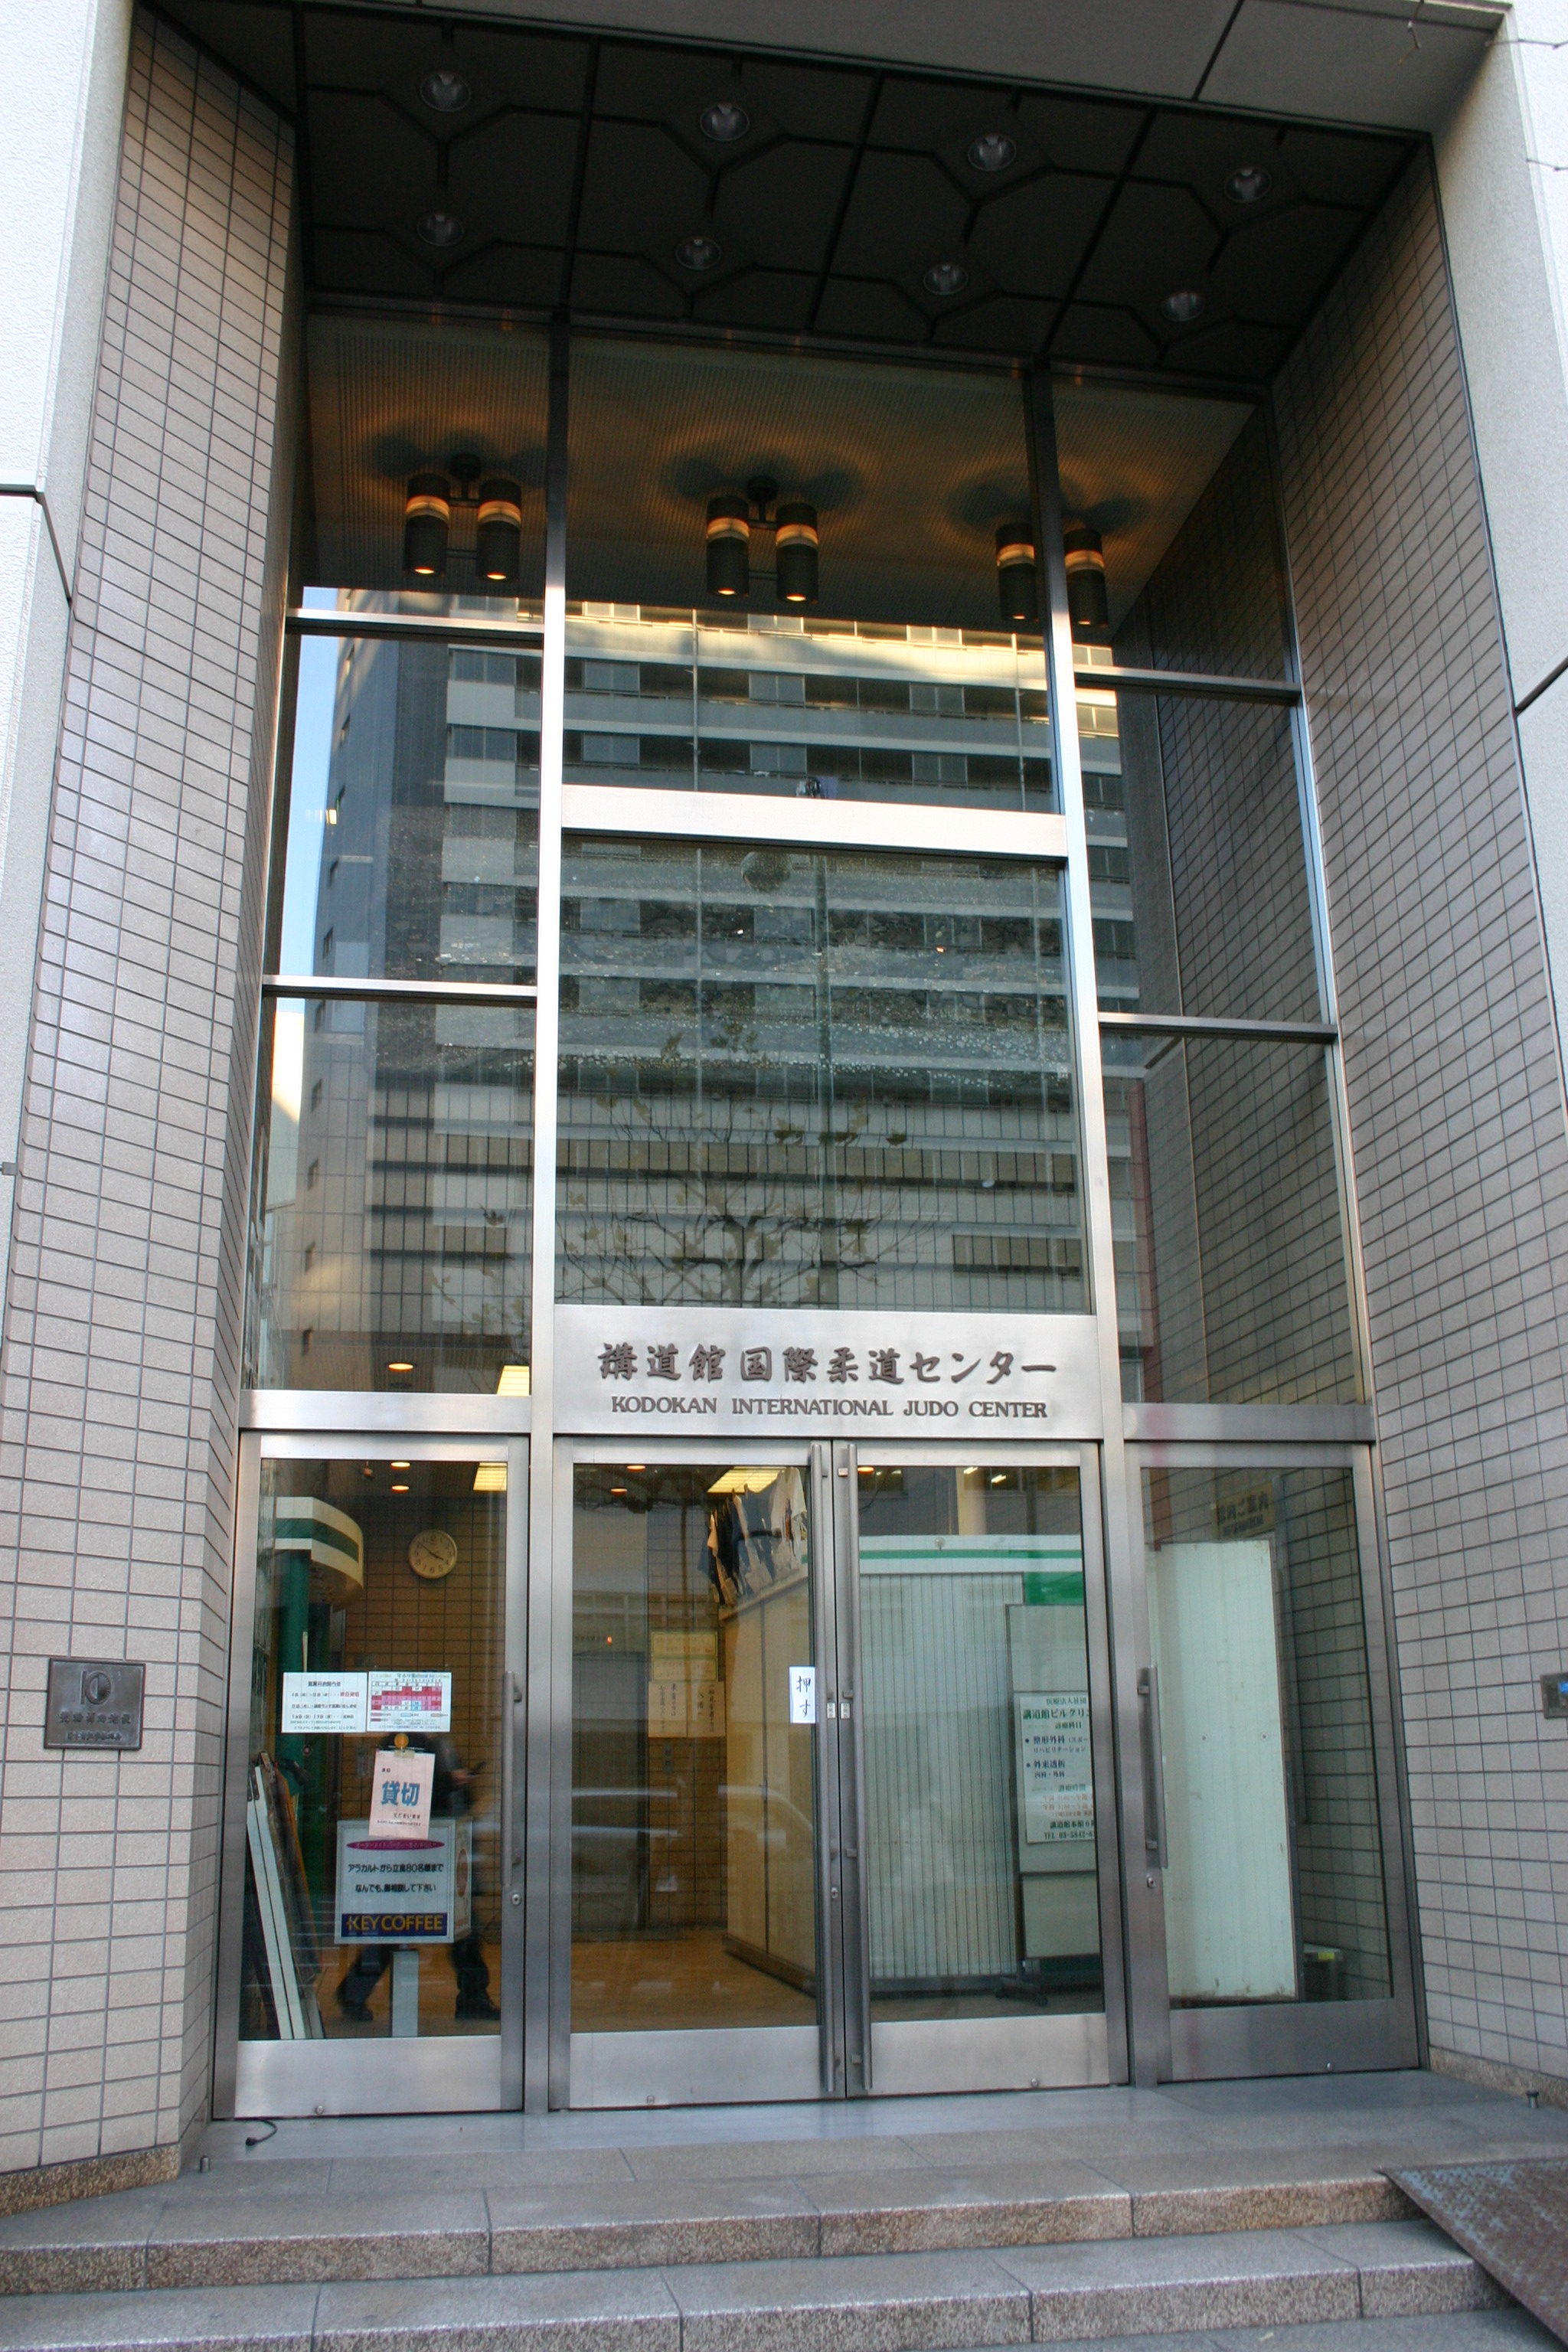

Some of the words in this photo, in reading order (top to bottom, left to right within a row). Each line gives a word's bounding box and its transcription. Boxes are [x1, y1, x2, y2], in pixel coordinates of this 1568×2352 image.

[612, 1396, 717, 1414] KODOKAN
[732, 1398, 894, 1416] INTERNATIONAL
[903, 1400, 959, 1416] JUDO
[969, 1401, 1048, 1418] CENTER
[796, 1675, 812, 1717] 押す
[381, 1780, 420, 1807] 貸切
[347, 1915, 380, 1931] KEY
[381, 1915, 443, 1931] COFFEE
